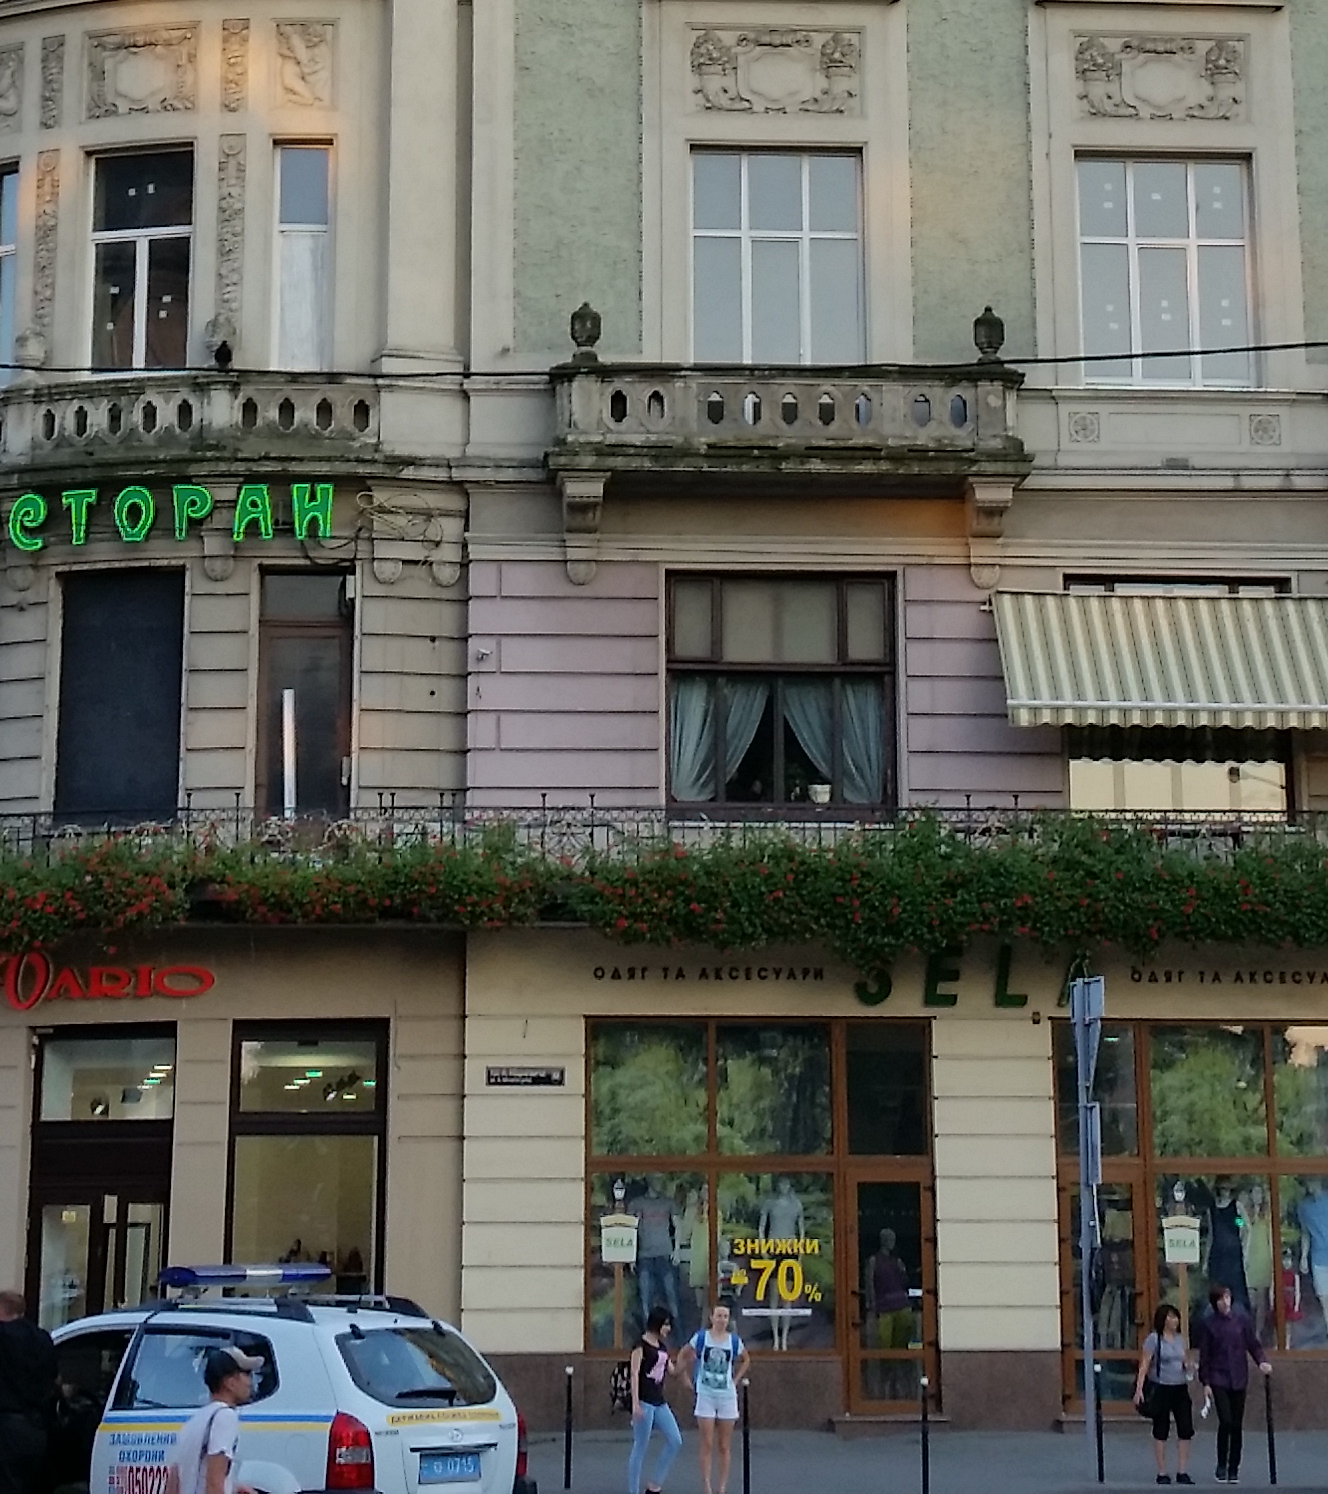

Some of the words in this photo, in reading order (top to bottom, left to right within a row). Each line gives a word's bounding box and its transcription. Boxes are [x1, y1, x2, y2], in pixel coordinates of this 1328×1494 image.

[593, 966, 648, 981] ОДЯГ
[662, 967, 686, 981] ТА
[698, 966, 824, 981] АКСЕСУАРИ
[1130, 968, 1185, 983] ОДЯГ
[1198, 969, 1222, 984] ТА
[732, 1237, 820, 1255] ЗНИЖКИ
